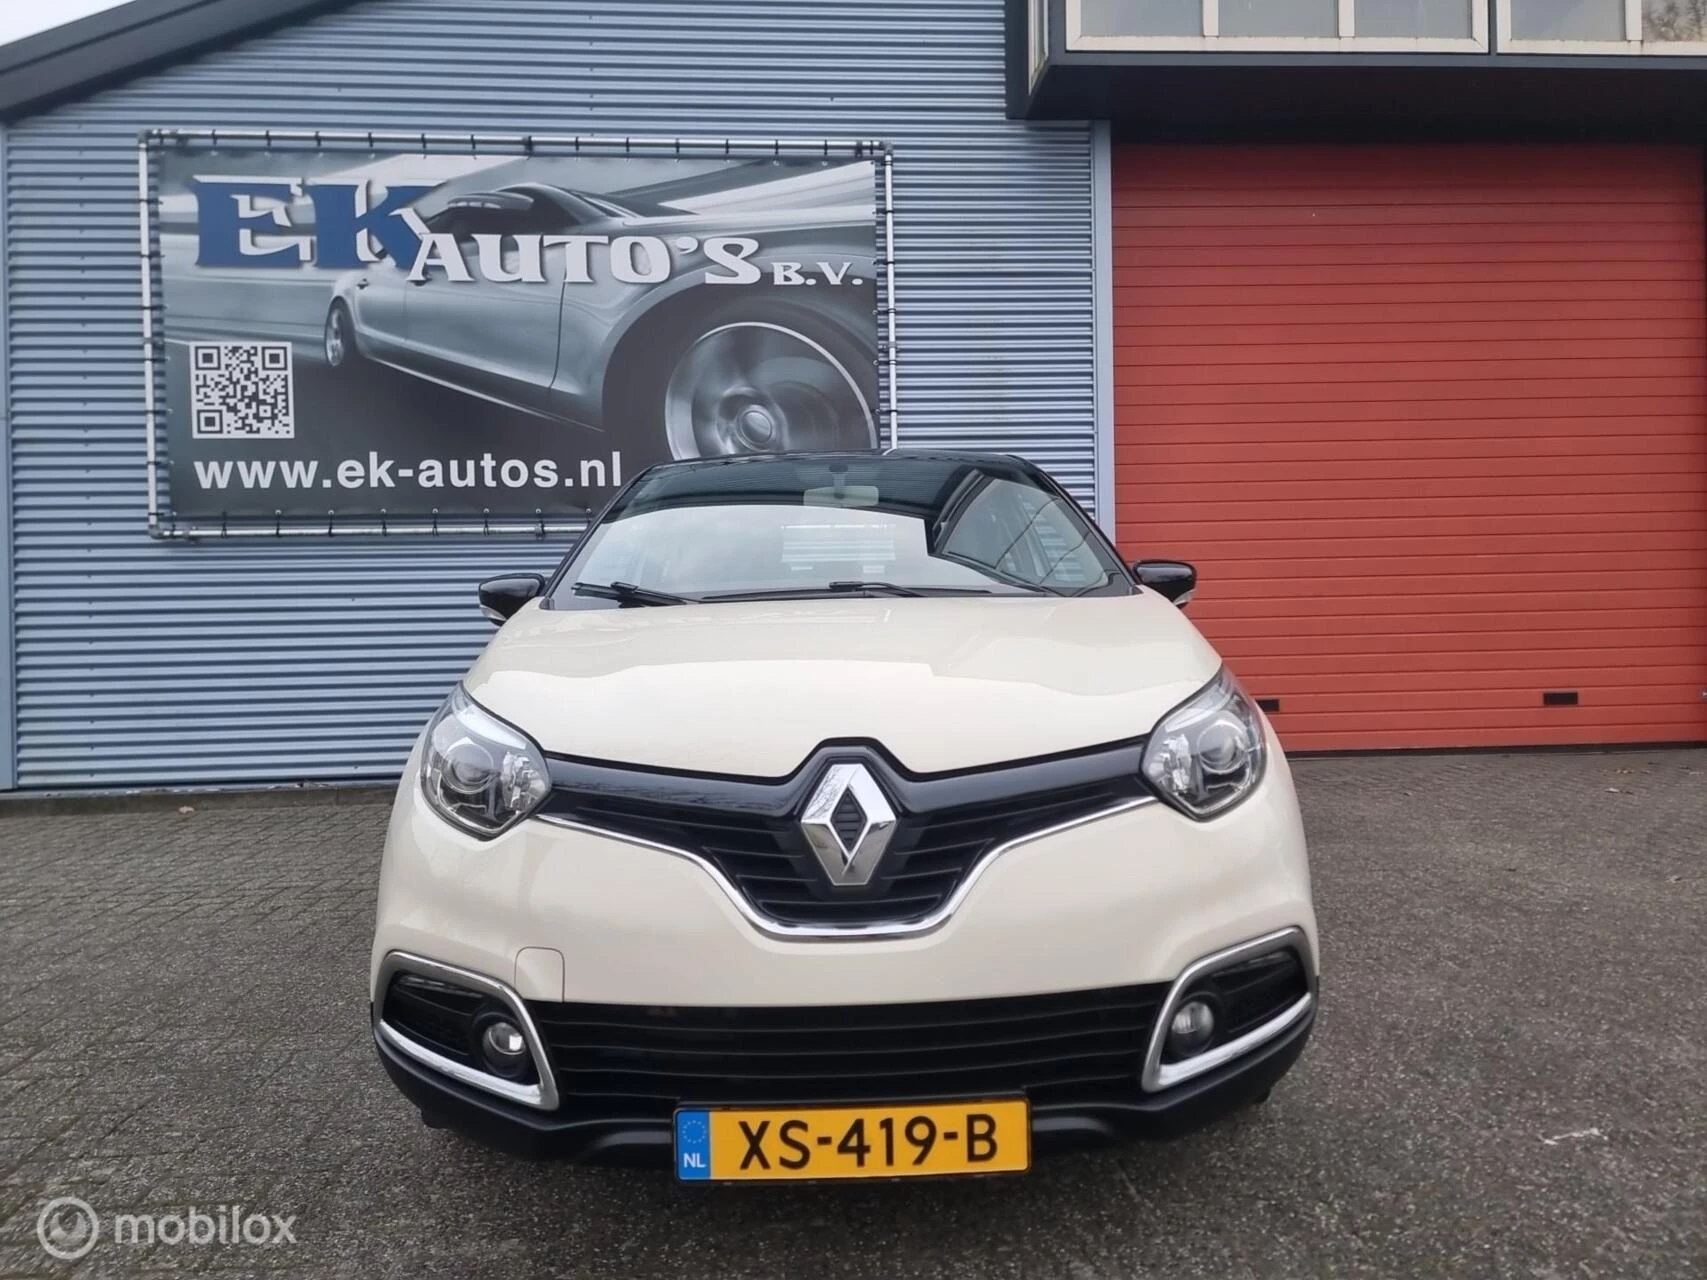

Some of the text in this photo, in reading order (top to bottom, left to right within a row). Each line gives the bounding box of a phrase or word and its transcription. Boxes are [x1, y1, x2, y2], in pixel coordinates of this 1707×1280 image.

[193, 174, 448, 270] EK
[772, 261, 864, 286] B.V.
[194, 451, 622, 490] www.ek-autos.nl
[683, 1153, 707, 1168] NL
[739, 1113, 998, 1170] XS-419-B
